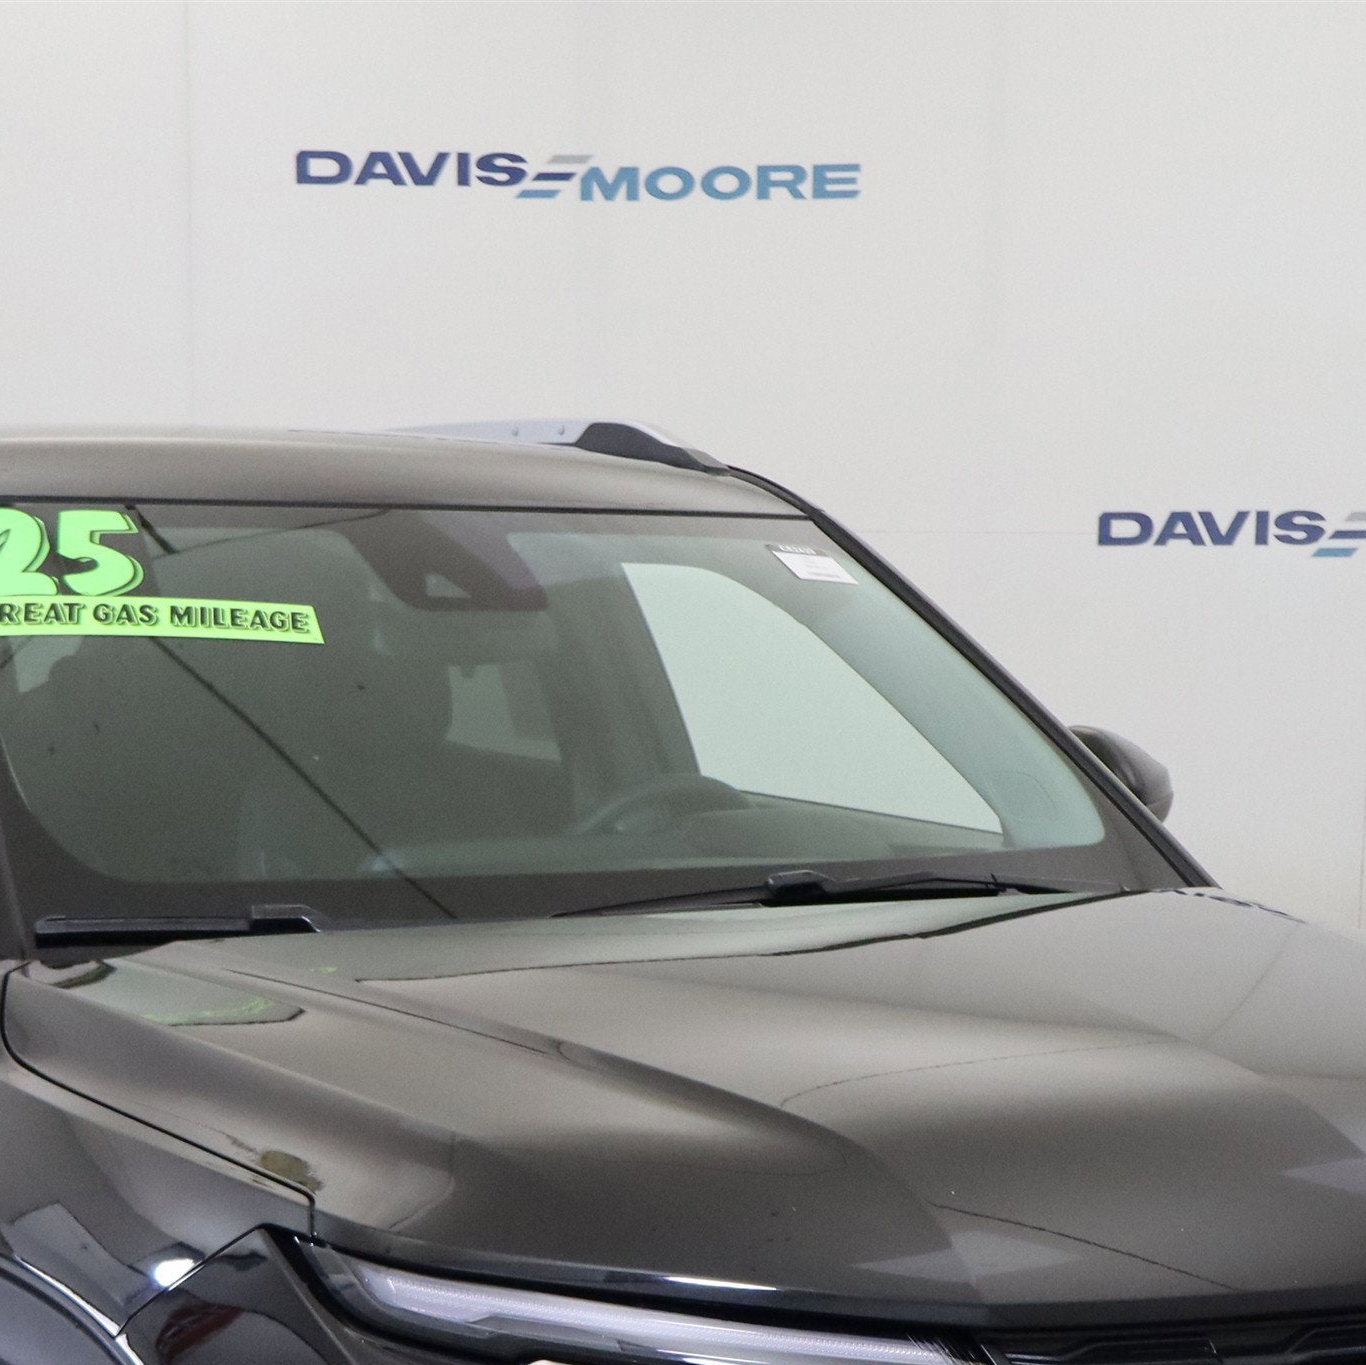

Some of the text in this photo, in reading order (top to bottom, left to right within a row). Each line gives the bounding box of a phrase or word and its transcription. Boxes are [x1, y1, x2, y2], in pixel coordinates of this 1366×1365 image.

[295, 150, 861, 202] DAVIS MOORE
[1097, 510, 1326, 547] DAVIS
[91, 602, 160, 627] GAS
[169, 603, 312, 633] MILEAGE
